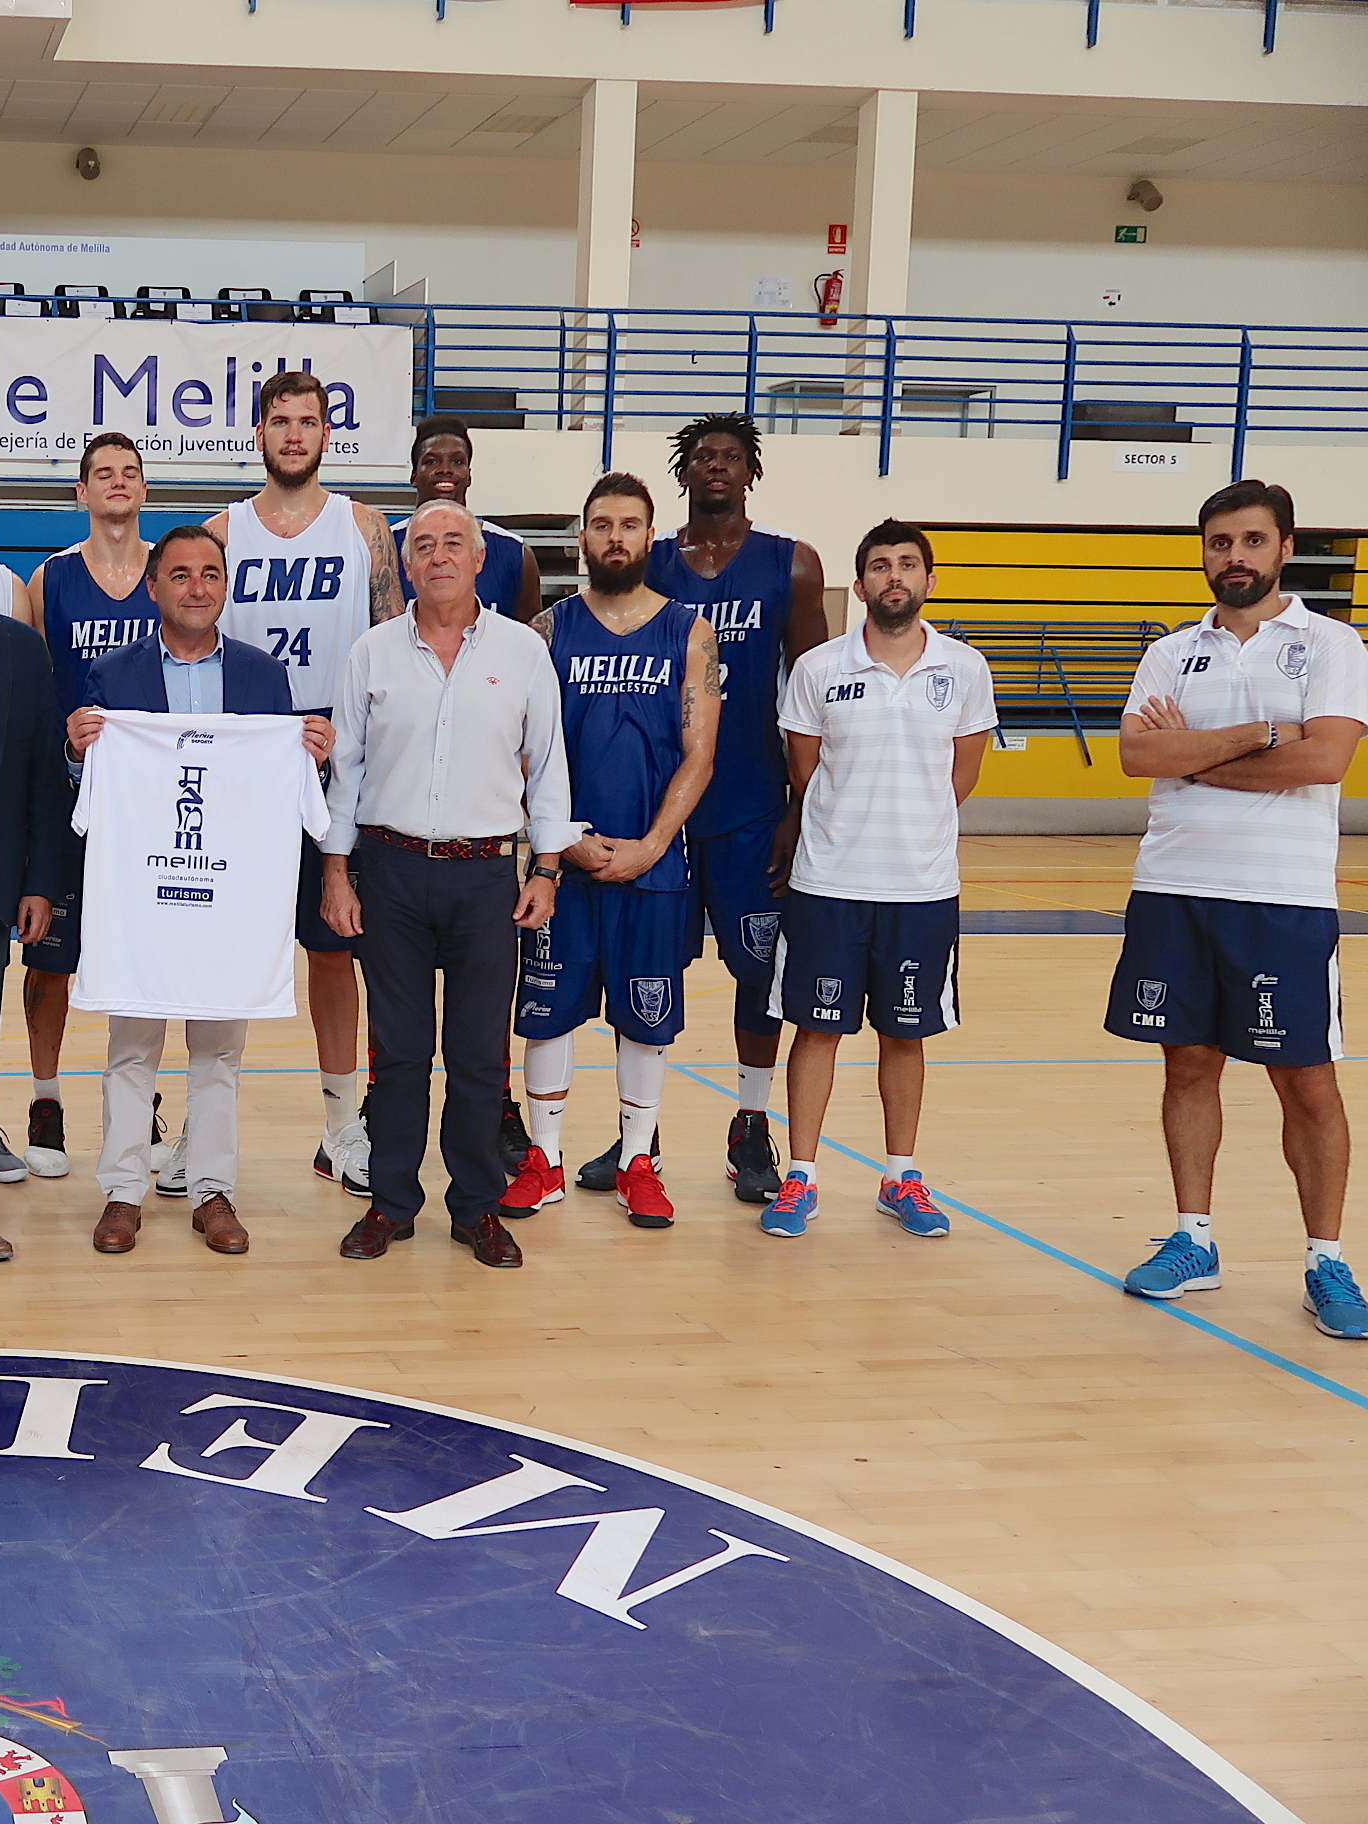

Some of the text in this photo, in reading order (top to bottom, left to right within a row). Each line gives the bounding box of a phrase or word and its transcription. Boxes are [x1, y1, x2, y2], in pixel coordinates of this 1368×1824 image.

[19, 241, 64, 252] Autónoma
[67, 243, 78, 252] de
[80, 243, 111, 253] Melilla
[93, 353, 361, 431] Melia
[55, 432, 76, 450] de
[176, 435, 255, 455] Juventud
[1124, 454, 1177, 465] SECTOR 5
[232, 556, 345, 603] CMB
[266, 627, 312, 667] 24
[568, 655, 672, 687] MELILLA
[580, 681, 658, 695] BALONCESTO
[825, 682, 866, 704] CMB
[147, 855, 227, 871] melilla
[161, 887, 210, 900] turismo
[523, 957, 563, 970] melilla
[813, 1007, 841, 1021] CMB
[1132, 1012, 1166, 1028] CMB
